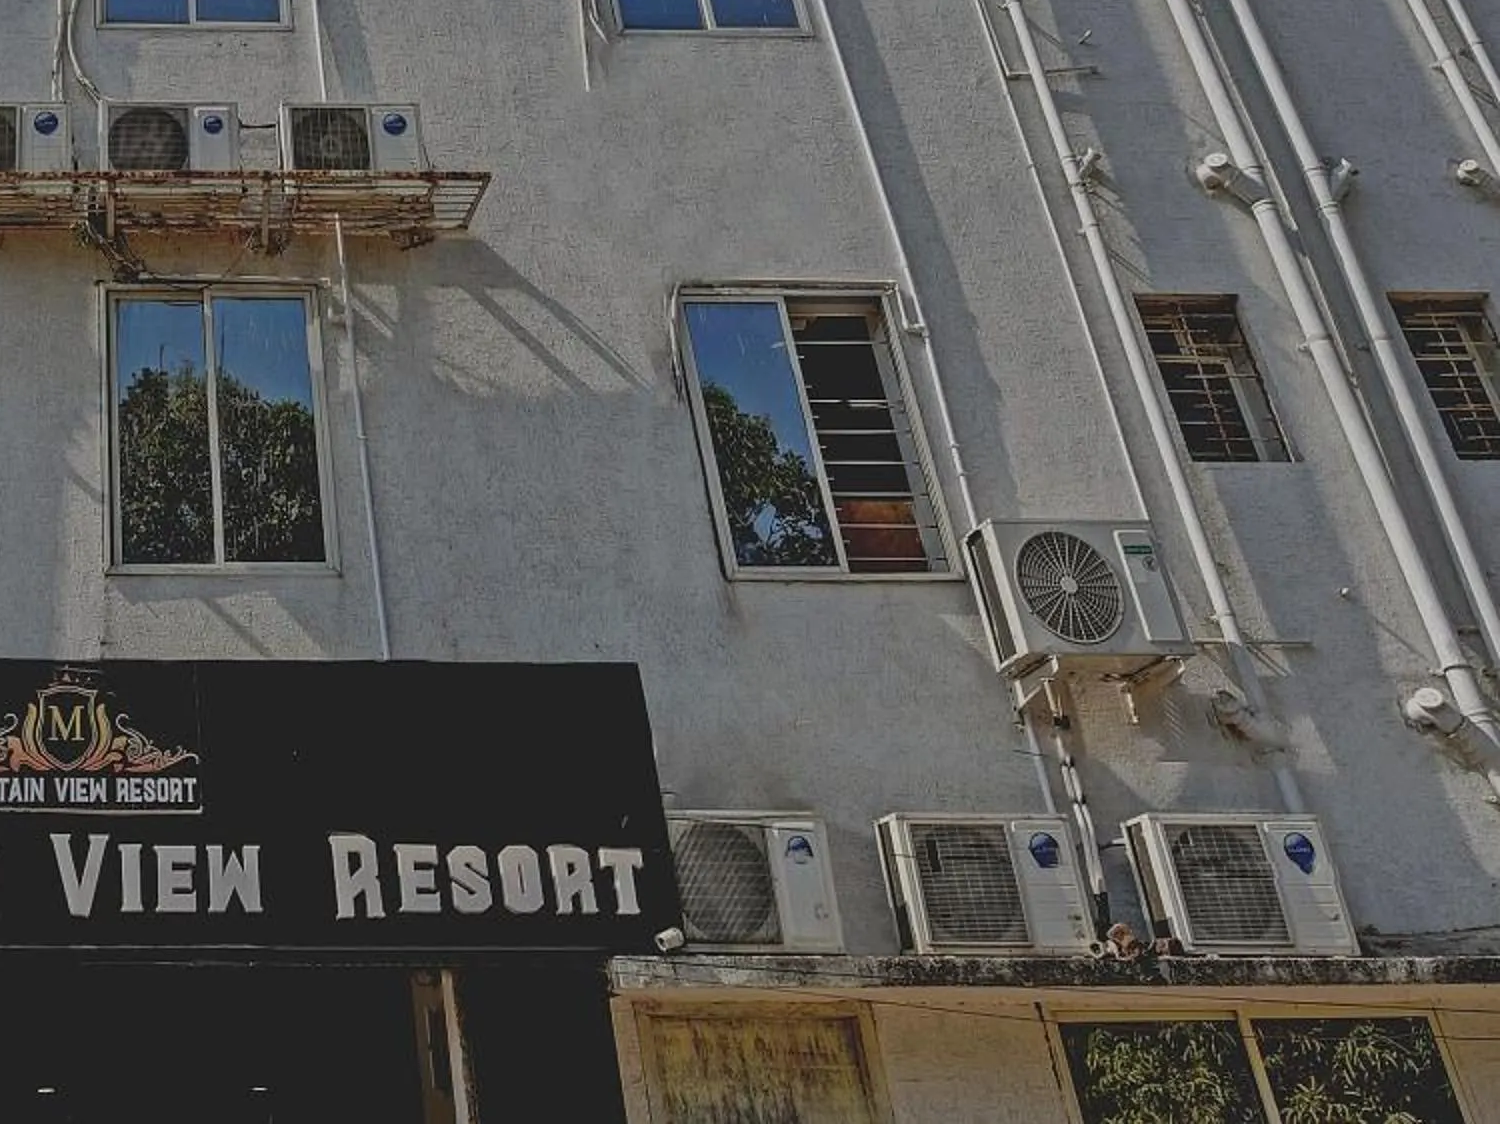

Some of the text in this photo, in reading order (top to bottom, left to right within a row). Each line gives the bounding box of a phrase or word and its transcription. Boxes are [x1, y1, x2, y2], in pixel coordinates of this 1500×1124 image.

[47, 704, 86, 742] M
[53, 777, 108, 804] VIEW
[114, 777, 198, 804] RESORT
